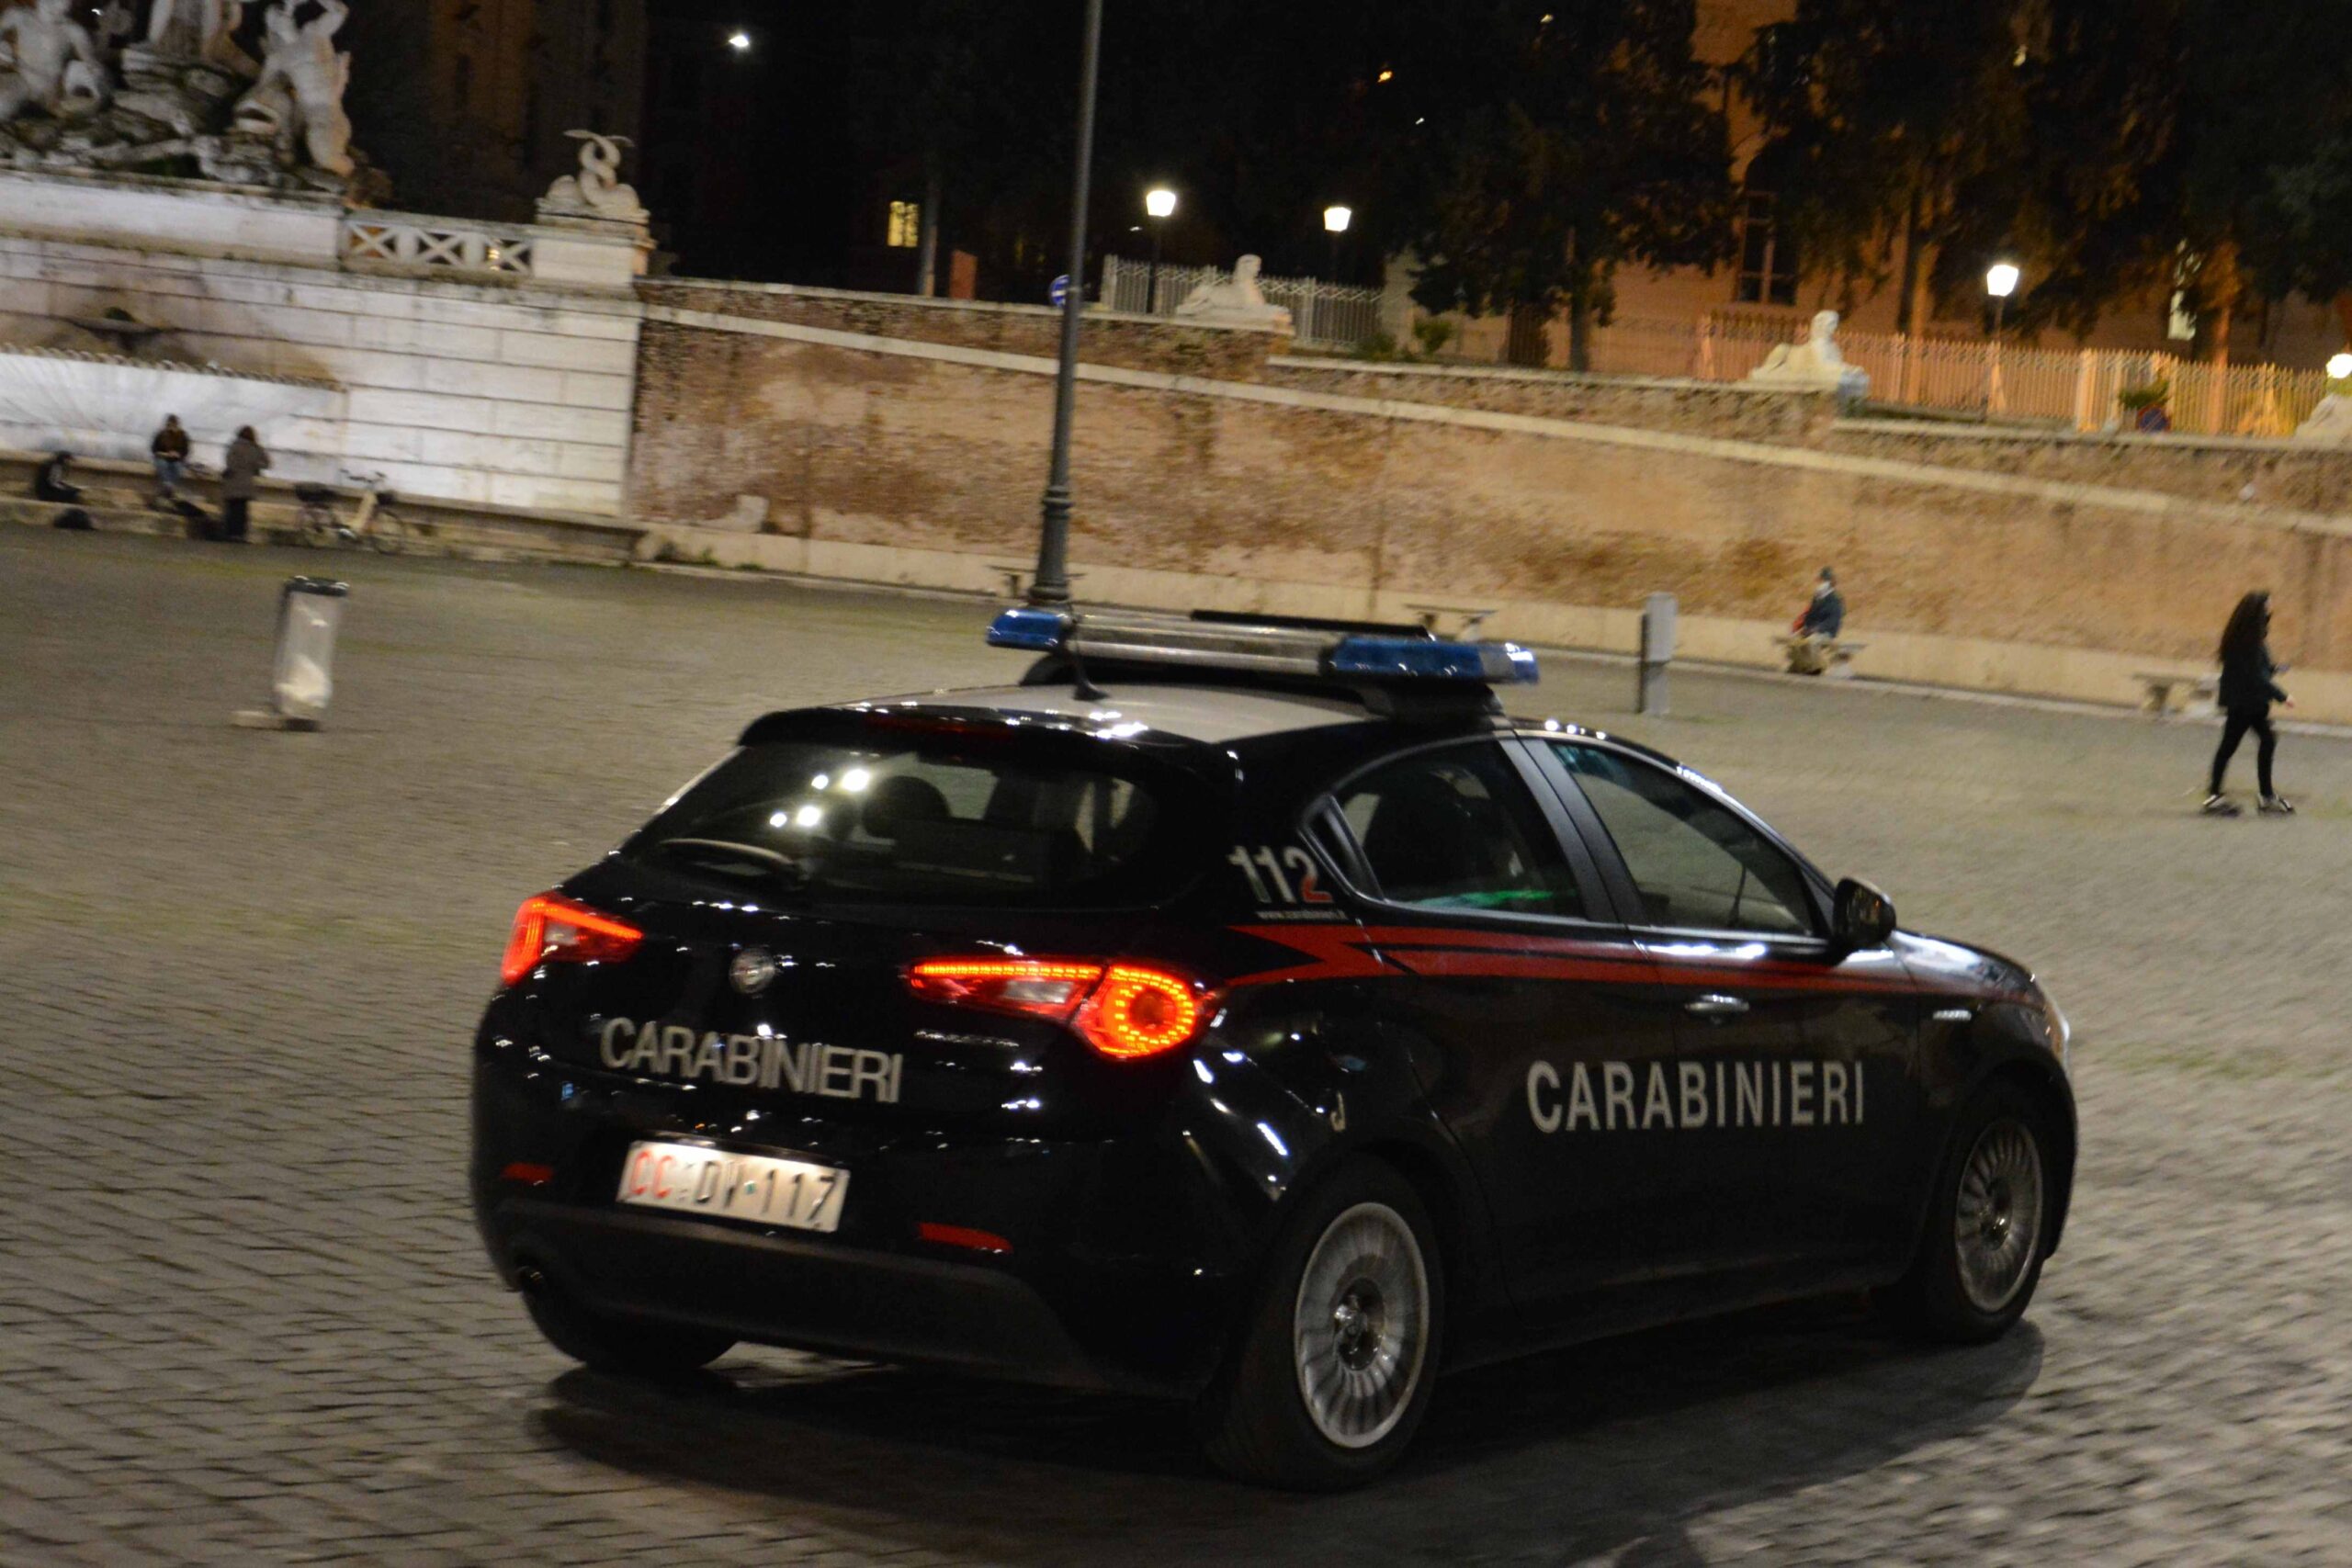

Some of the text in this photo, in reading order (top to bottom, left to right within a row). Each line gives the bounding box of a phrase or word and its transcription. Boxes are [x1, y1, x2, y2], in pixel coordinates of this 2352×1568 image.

[1226, 844, 1333, 904] 112
[600, 1016, 904, 1103] CARABINIERI
[1526, 1059, 1864, 1134] CARABINIERI
